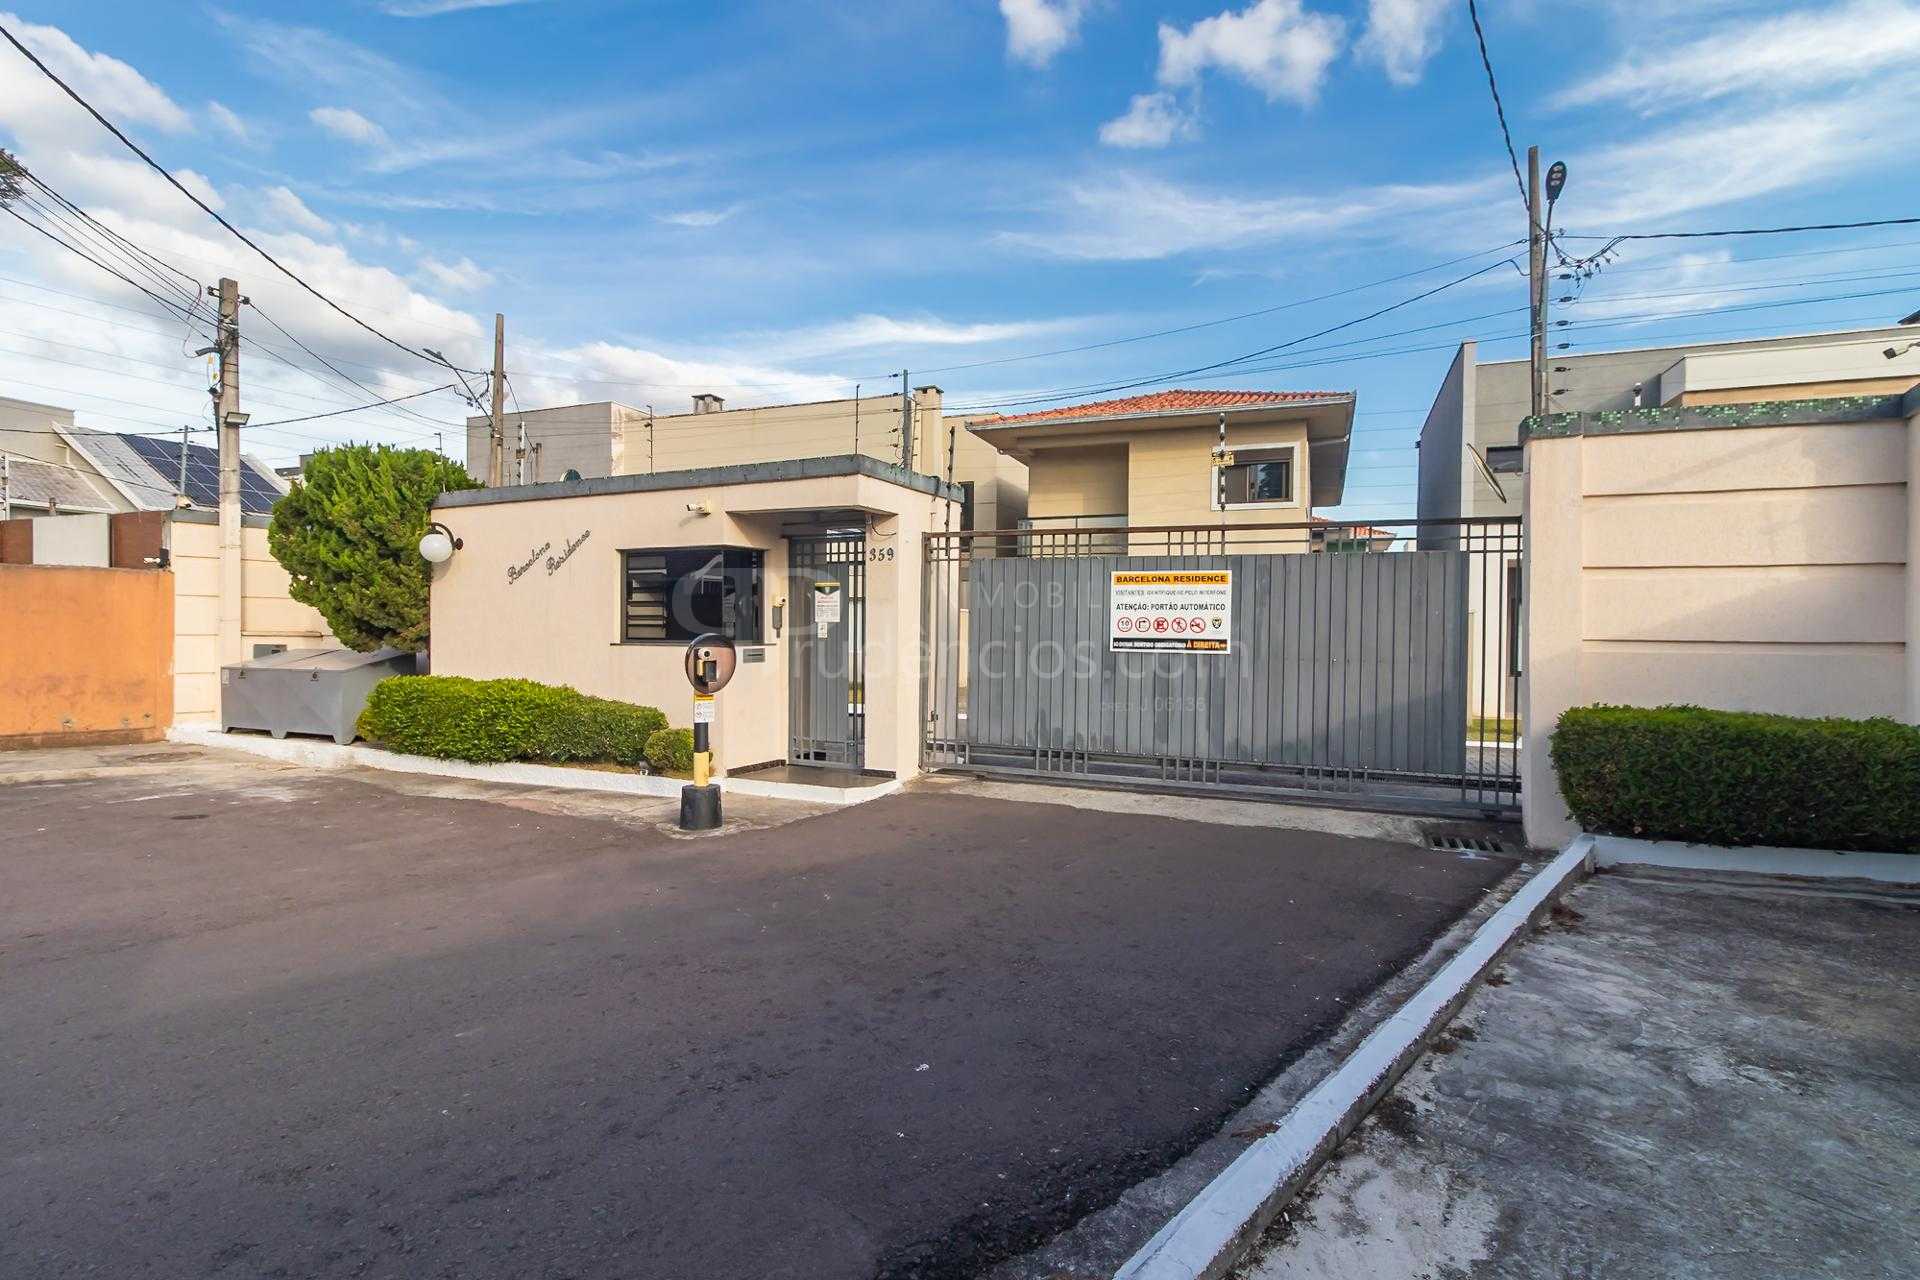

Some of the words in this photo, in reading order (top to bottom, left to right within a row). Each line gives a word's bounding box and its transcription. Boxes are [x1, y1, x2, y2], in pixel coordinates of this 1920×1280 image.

[869, 547, 894, 561] 359
[1116, 575, 1170, 583] BARCELONA
[1173, 575, 1226, 583] RESIDENCE
[1116, 603, 1149, 612] ATENÇÃO:
[1151, 602, 1178, 611] PORTÃO
[1180, 602, 1226, 611] AUTOMÁTICO
[1194, 640, 1220, 649] DIREITA
